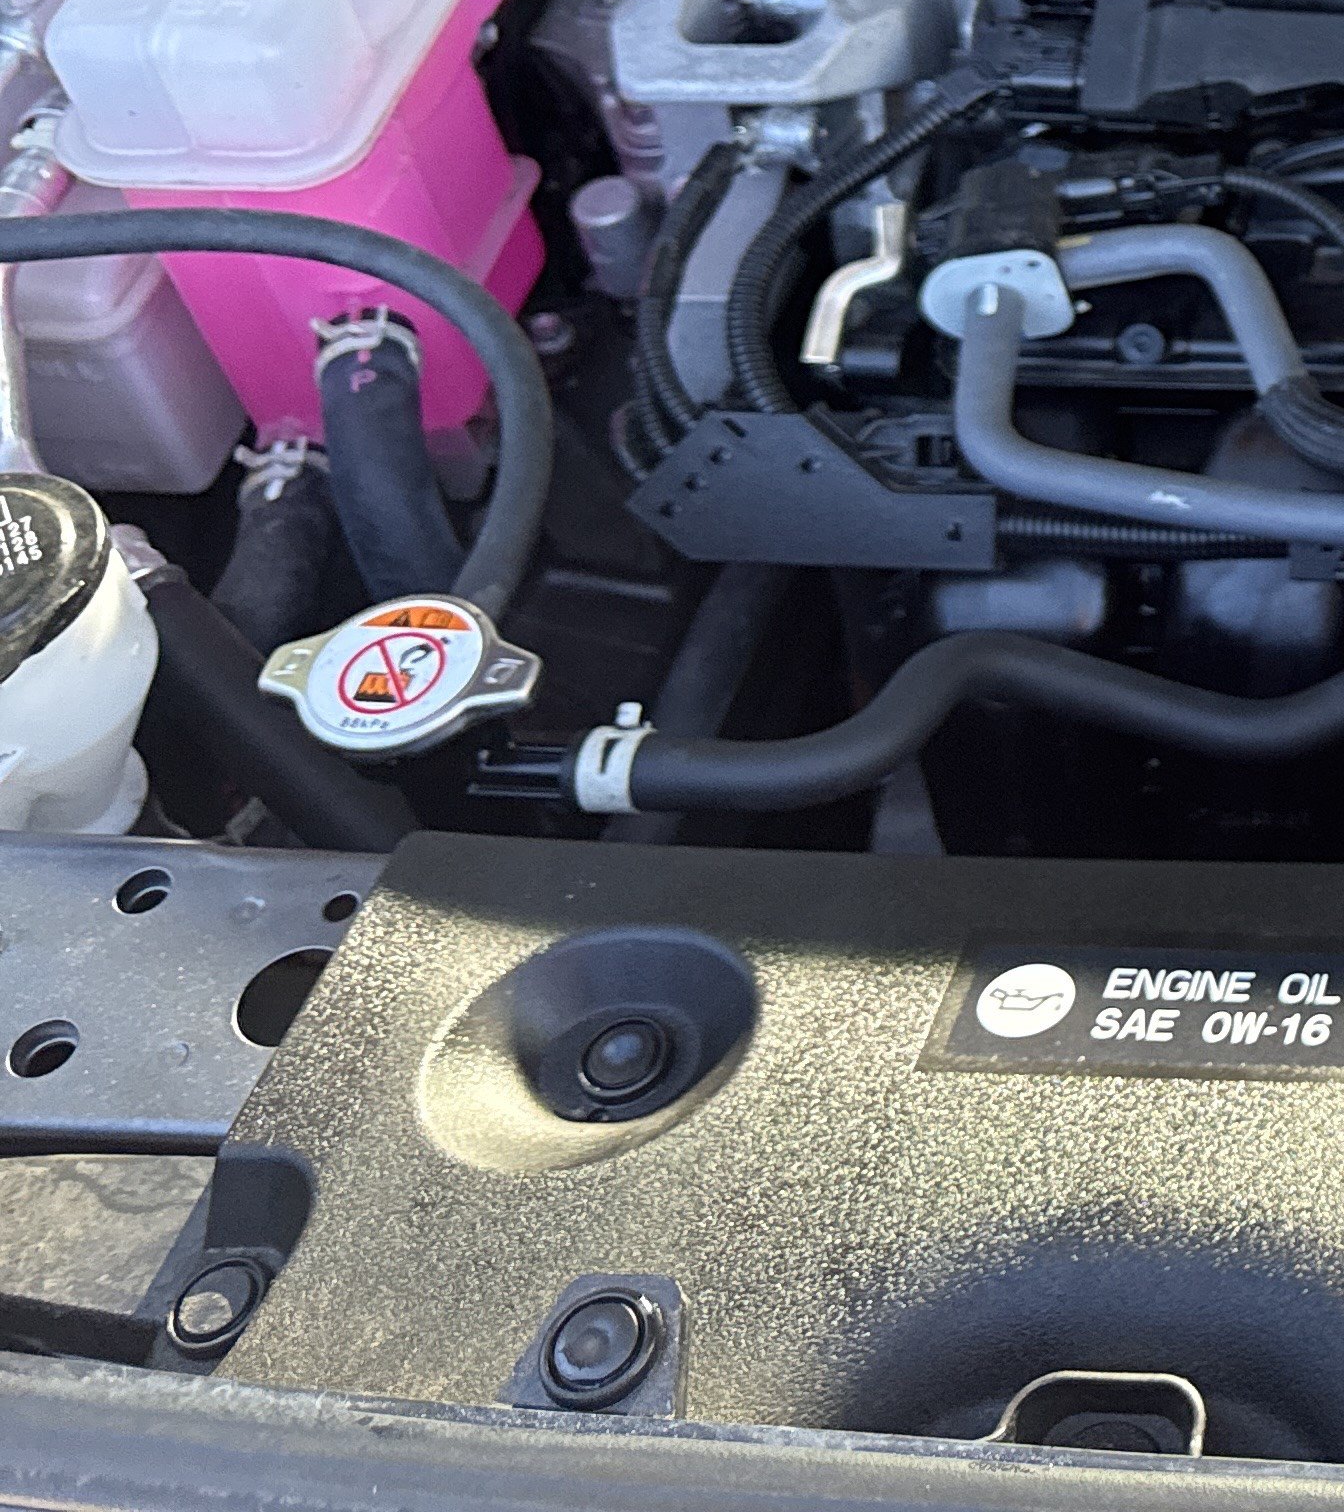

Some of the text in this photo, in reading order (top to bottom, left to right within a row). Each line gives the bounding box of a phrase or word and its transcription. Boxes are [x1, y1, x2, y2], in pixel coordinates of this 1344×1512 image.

[1102, 967, 1341, 1005] ENGINE OIL
[1090, 1007, 1181, 1042] SAE
